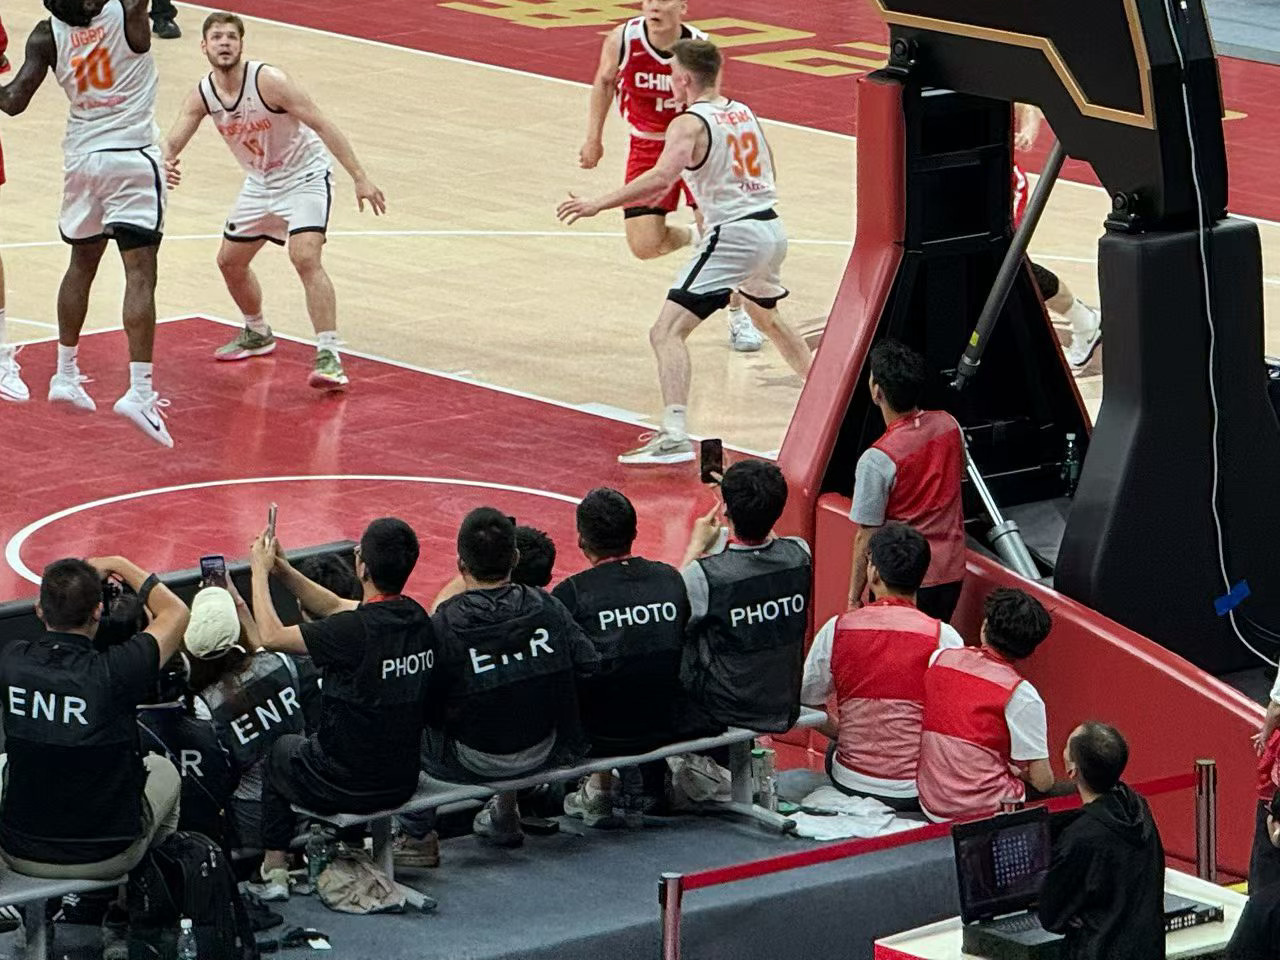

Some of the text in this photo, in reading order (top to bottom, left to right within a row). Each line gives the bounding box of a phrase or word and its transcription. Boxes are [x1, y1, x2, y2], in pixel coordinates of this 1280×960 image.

[70, 47, 113, 94] 10
[727, 131, 762, 179] 32
[598, 601, 677, 631] PHOTO
[730, 593, 805, 627] PHOTO
[382, 648, 435, 680] PHOTO
[7, 685, 90, 726] ENR
[230, 686, 301, 746] ENR
